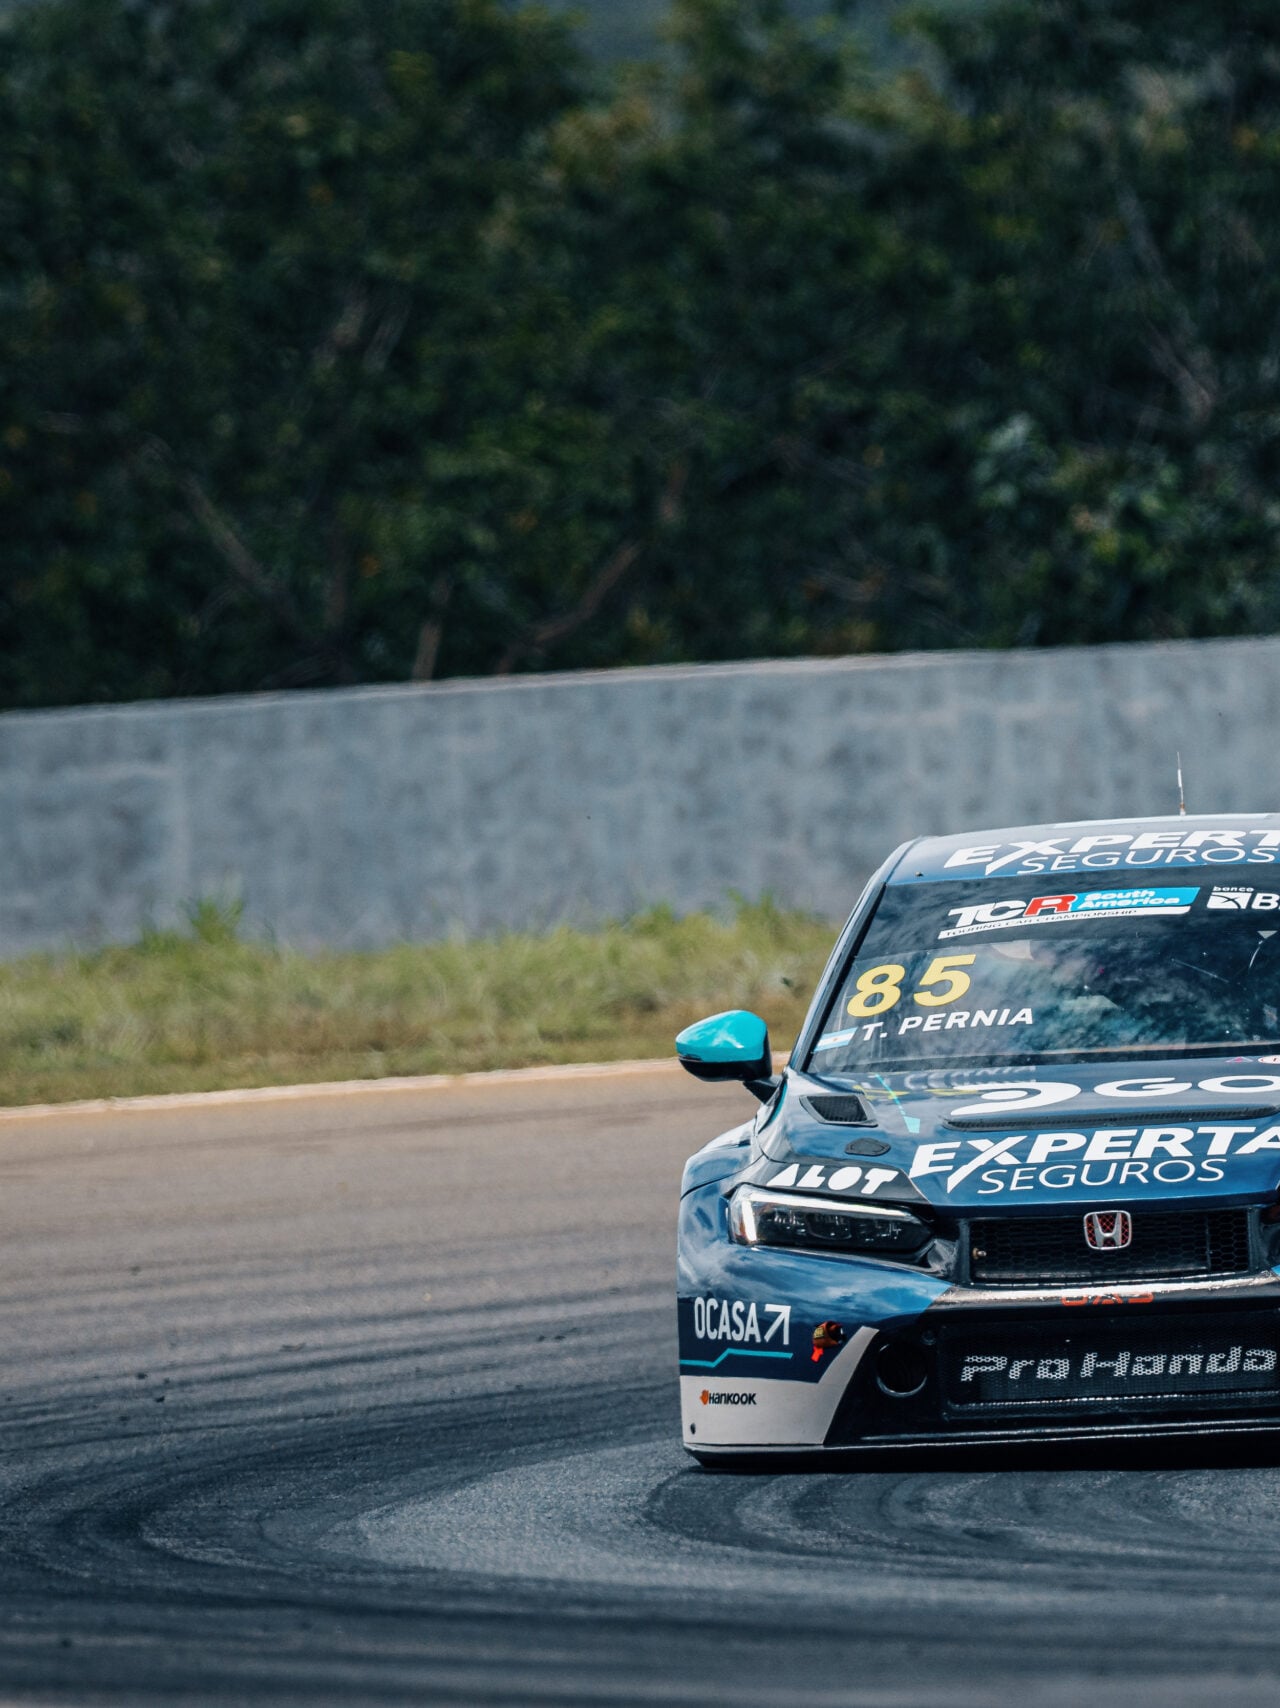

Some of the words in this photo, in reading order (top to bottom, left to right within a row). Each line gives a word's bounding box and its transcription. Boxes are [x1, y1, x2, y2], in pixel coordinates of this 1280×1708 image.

[1017, 847, 1279, 874] SEGUROS
[948, 894, 1078, 928] TCR
[1077, 897, 1180, 910] America
[1085, 889, 1156, 902] South
[847, 954, 976, 1017] 85
[862, 1021, 888, 1041] T.
[898, 1008, 1033, 1035] PERNIA
[766, 1163, 899, 1194] ALOT
[977, 1159, 1227, 1194] SEGUROS
